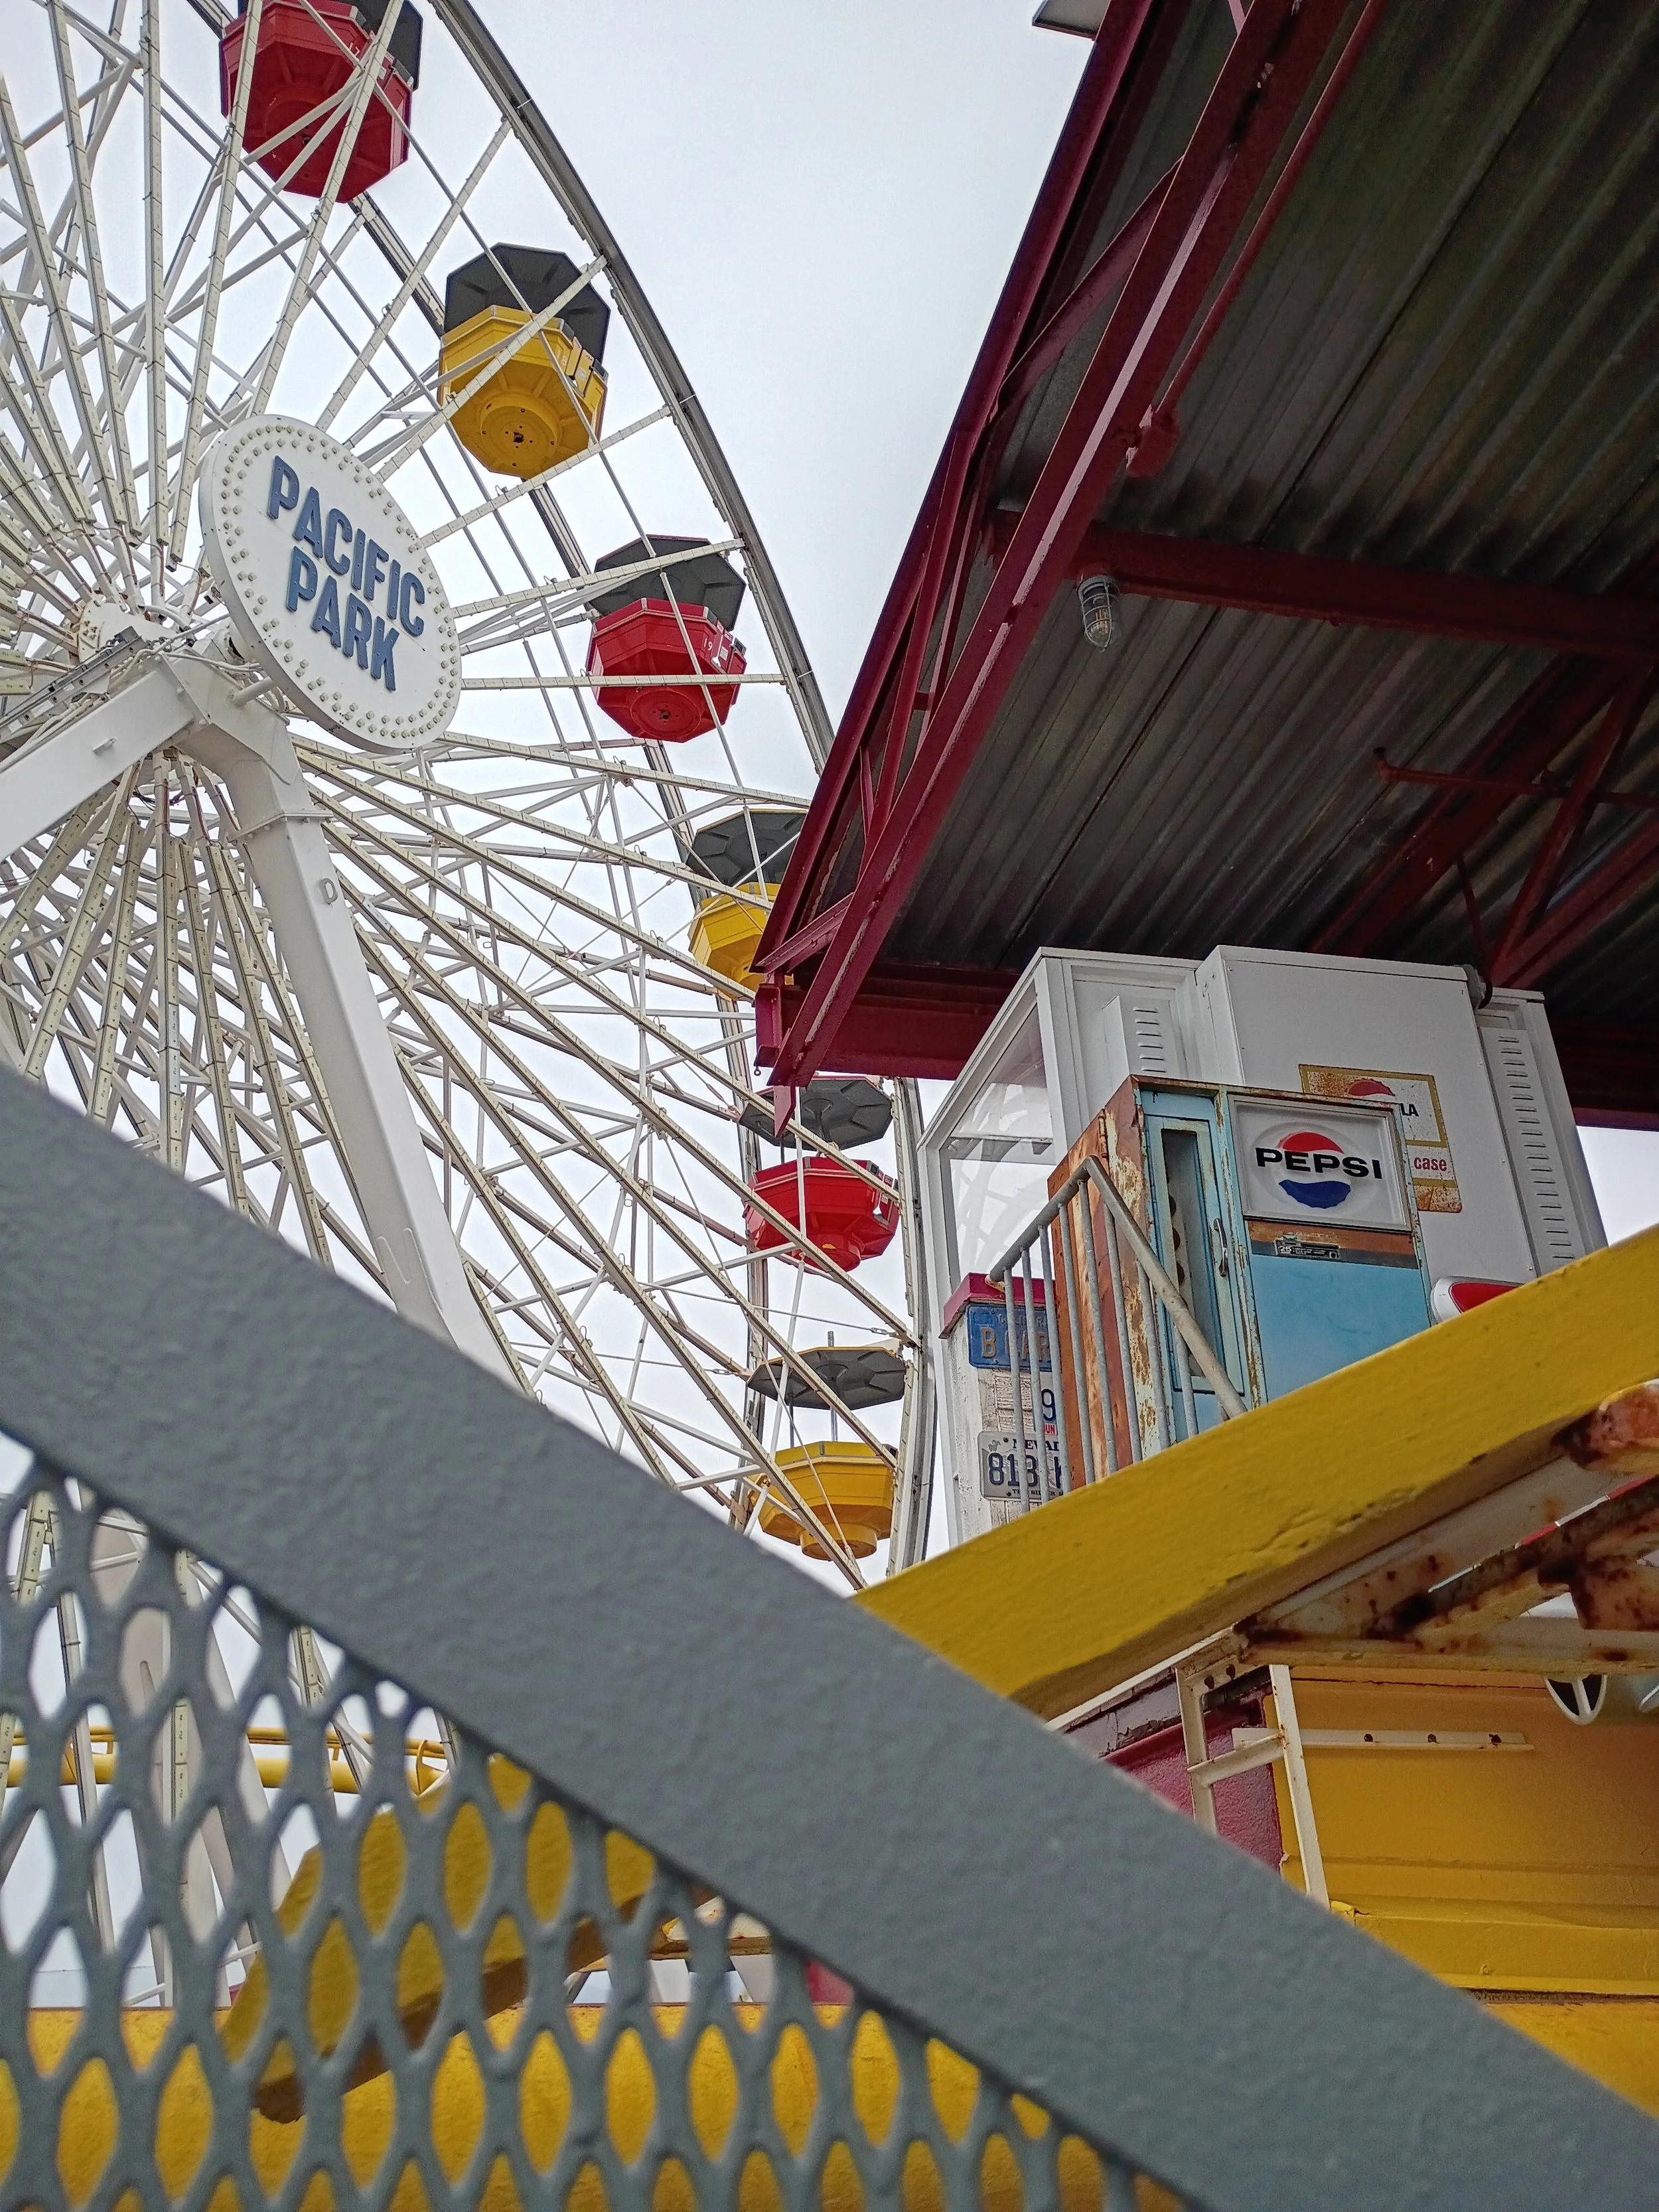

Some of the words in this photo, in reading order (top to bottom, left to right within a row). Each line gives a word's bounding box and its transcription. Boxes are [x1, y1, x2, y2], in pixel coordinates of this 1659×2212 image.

[267, 455, 425, 637] PACIFIC
[286, 546, 399, 692] PARK
[703, 638, 713, 651] 19
[1255, 1147, 1382, 1179] PEPSI
[1413, 1157, 1447, 1172] case
